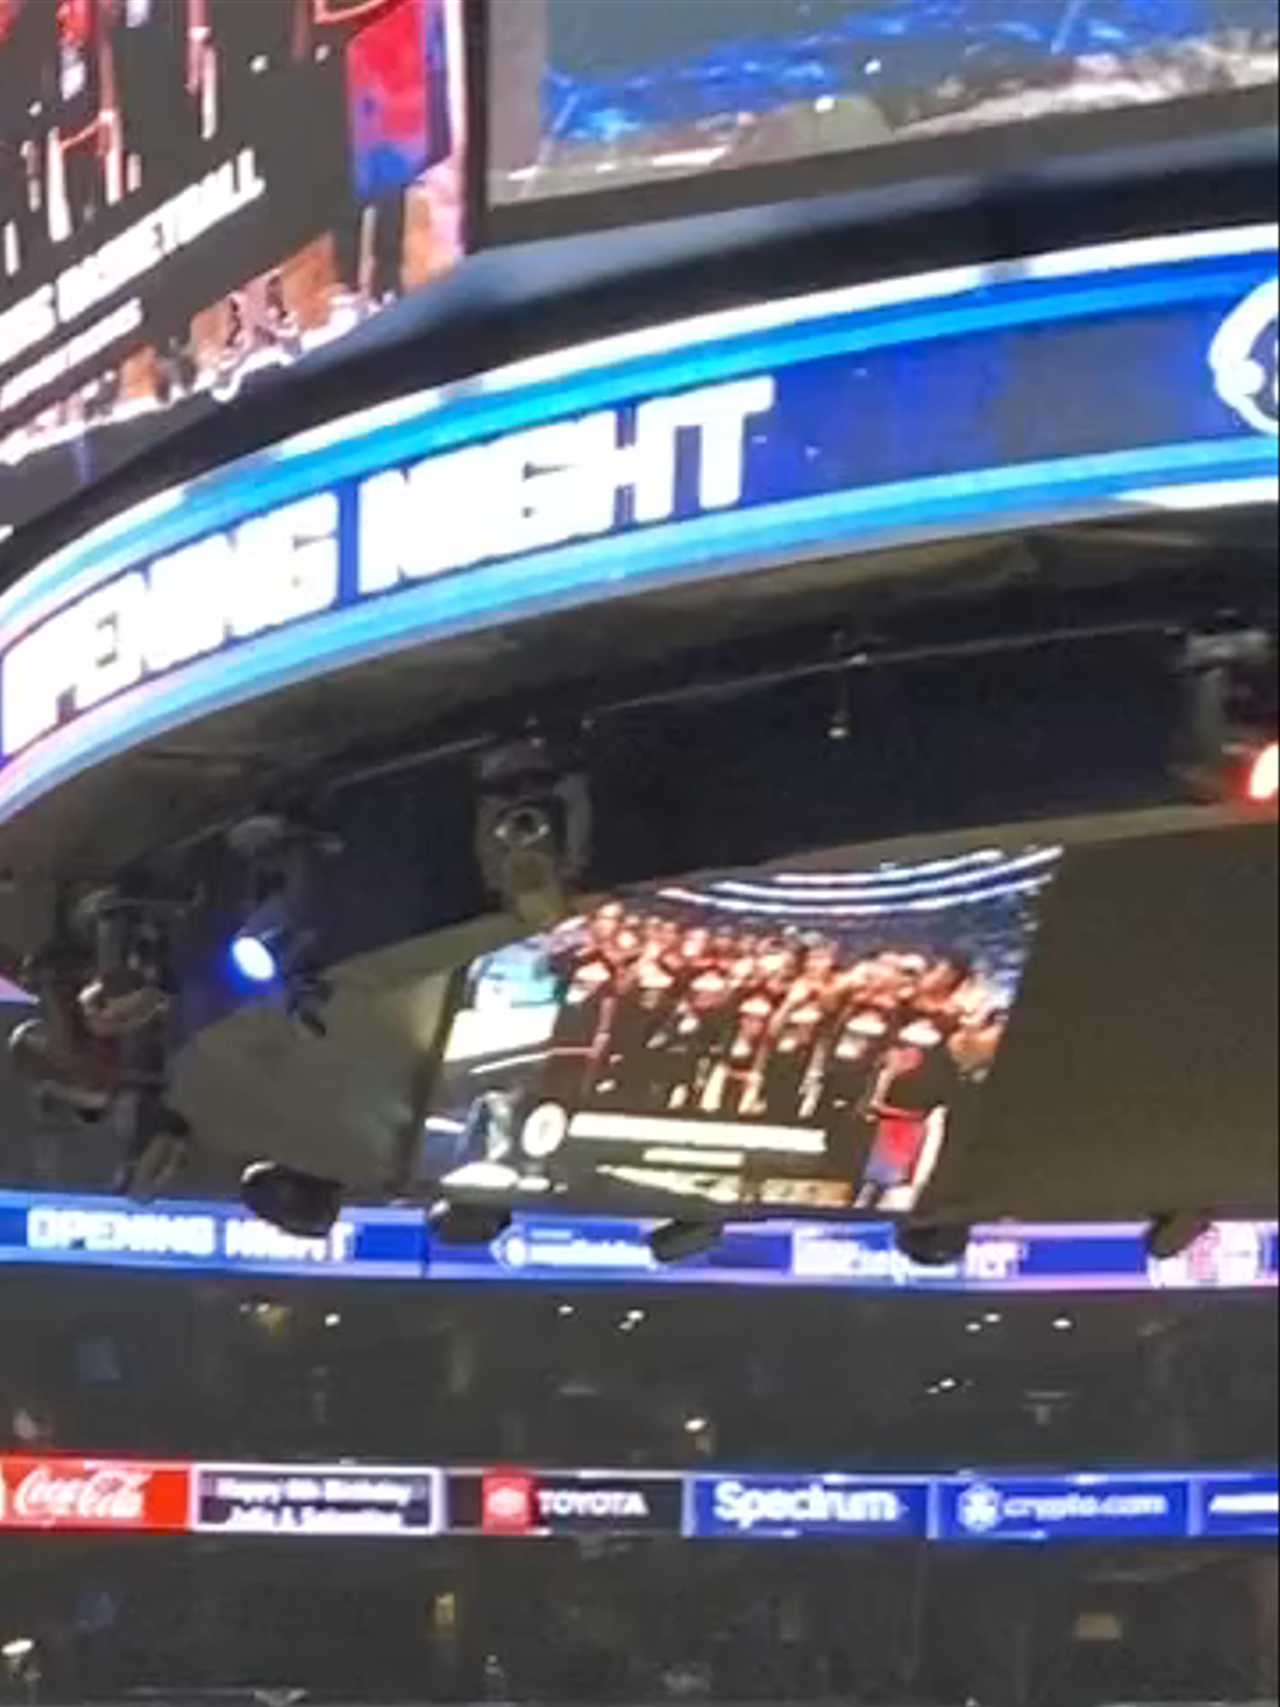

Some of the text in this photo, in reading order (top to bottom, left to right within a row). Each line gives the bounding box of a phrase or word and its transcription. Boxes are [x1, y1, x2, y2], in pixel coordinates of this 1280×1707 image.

[359, 377, 775, 594] NIGHT
[27, 1207, 214, 1255] OPENING
[539, 1490, 649, 1517] TOYOTA
[714, 1482, 899, 1527] Spectrum
